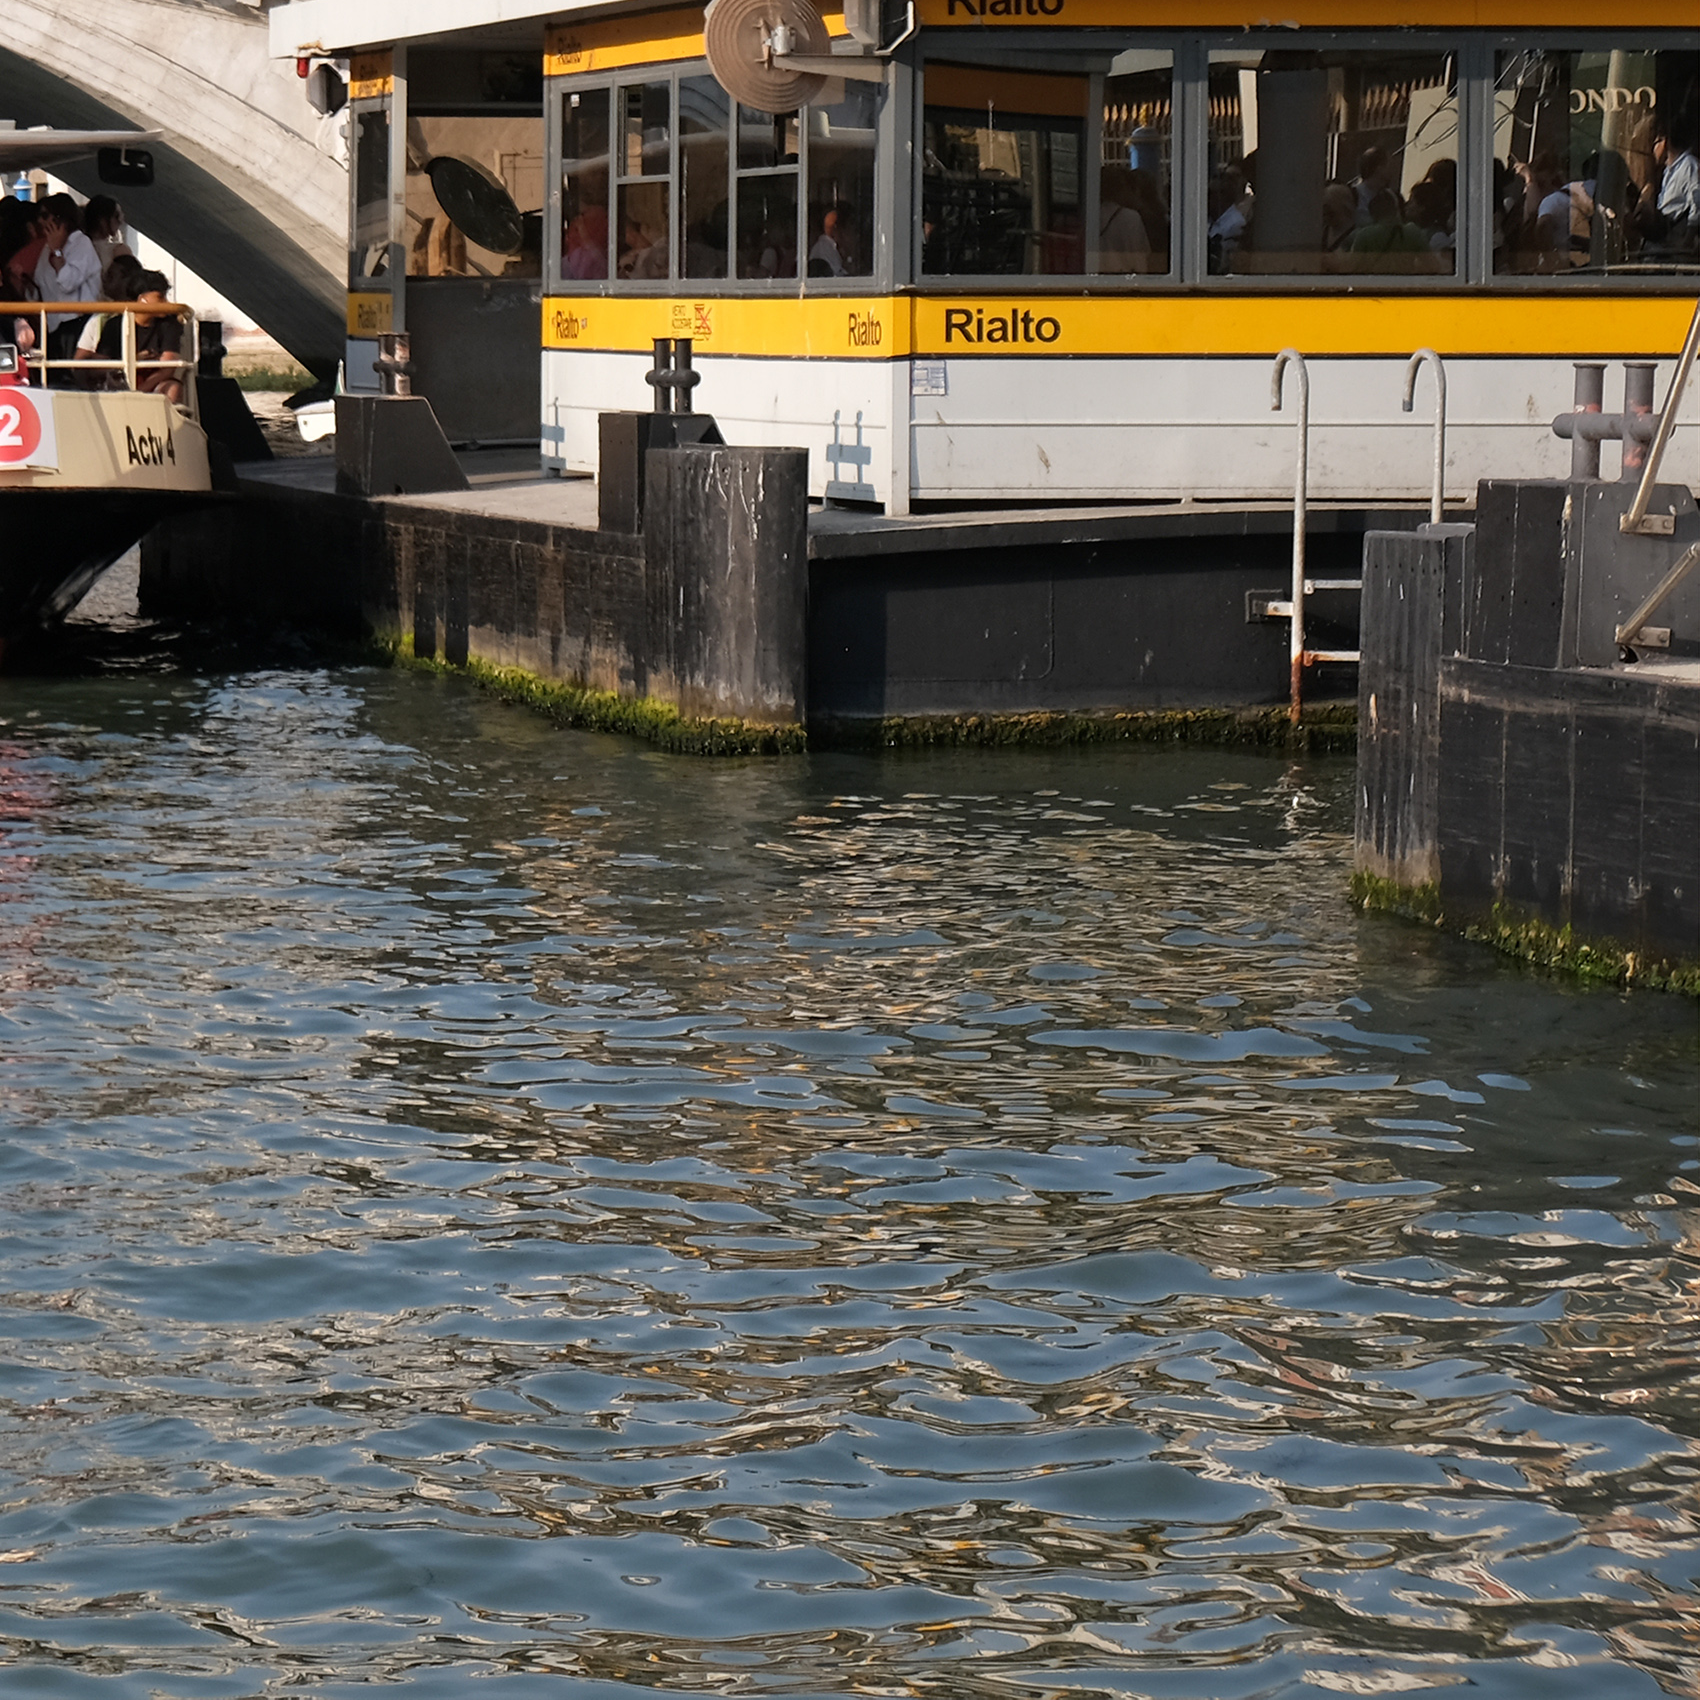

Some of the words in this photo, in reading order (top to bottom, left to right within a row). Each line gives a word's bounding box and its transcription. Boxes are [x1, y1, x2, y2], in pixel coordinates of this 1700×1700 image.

[556, 310, 579, 339] Rialto
[848, 311, 882, 347] Rialto
[945, 308, 1061, 343] Rialto
[126, 425, 163, 466] Actv
[166, 427, 176, 466] 4
